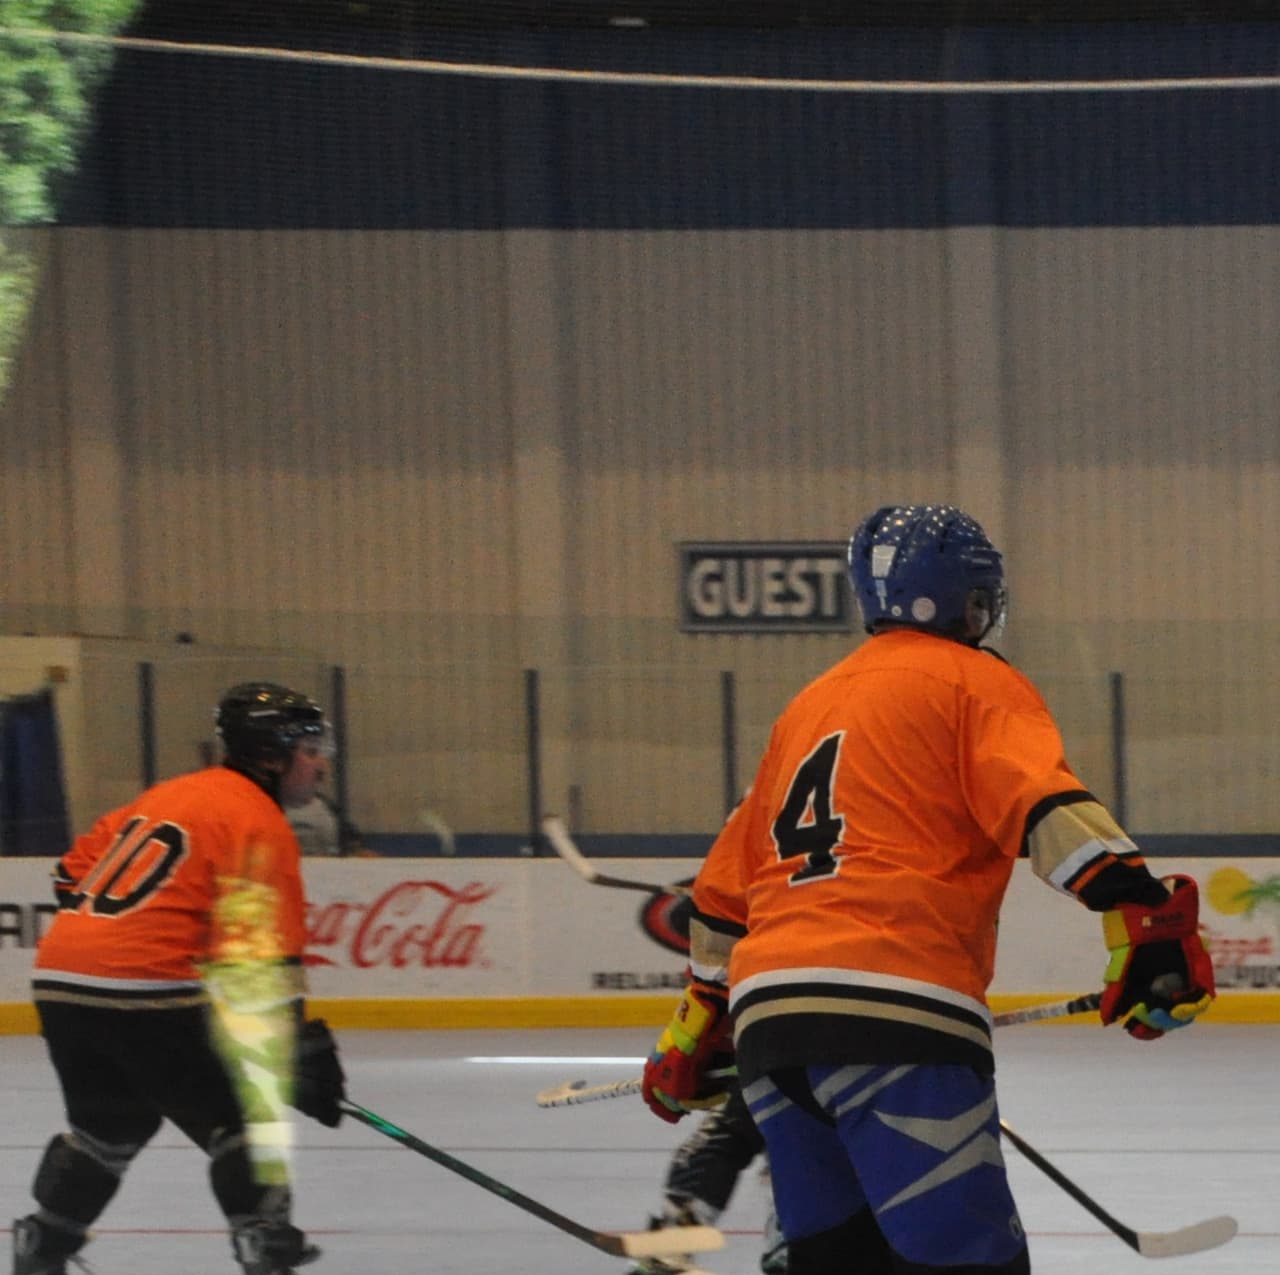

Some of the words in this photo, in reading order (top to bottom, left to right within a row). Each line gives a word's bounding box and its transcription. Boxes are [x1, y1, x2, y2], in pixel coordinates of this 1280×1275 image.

[688, 557, 843, 617] GUEST
[770, 729, 847, 887] 4
[58, 815, 191, 919] 10
